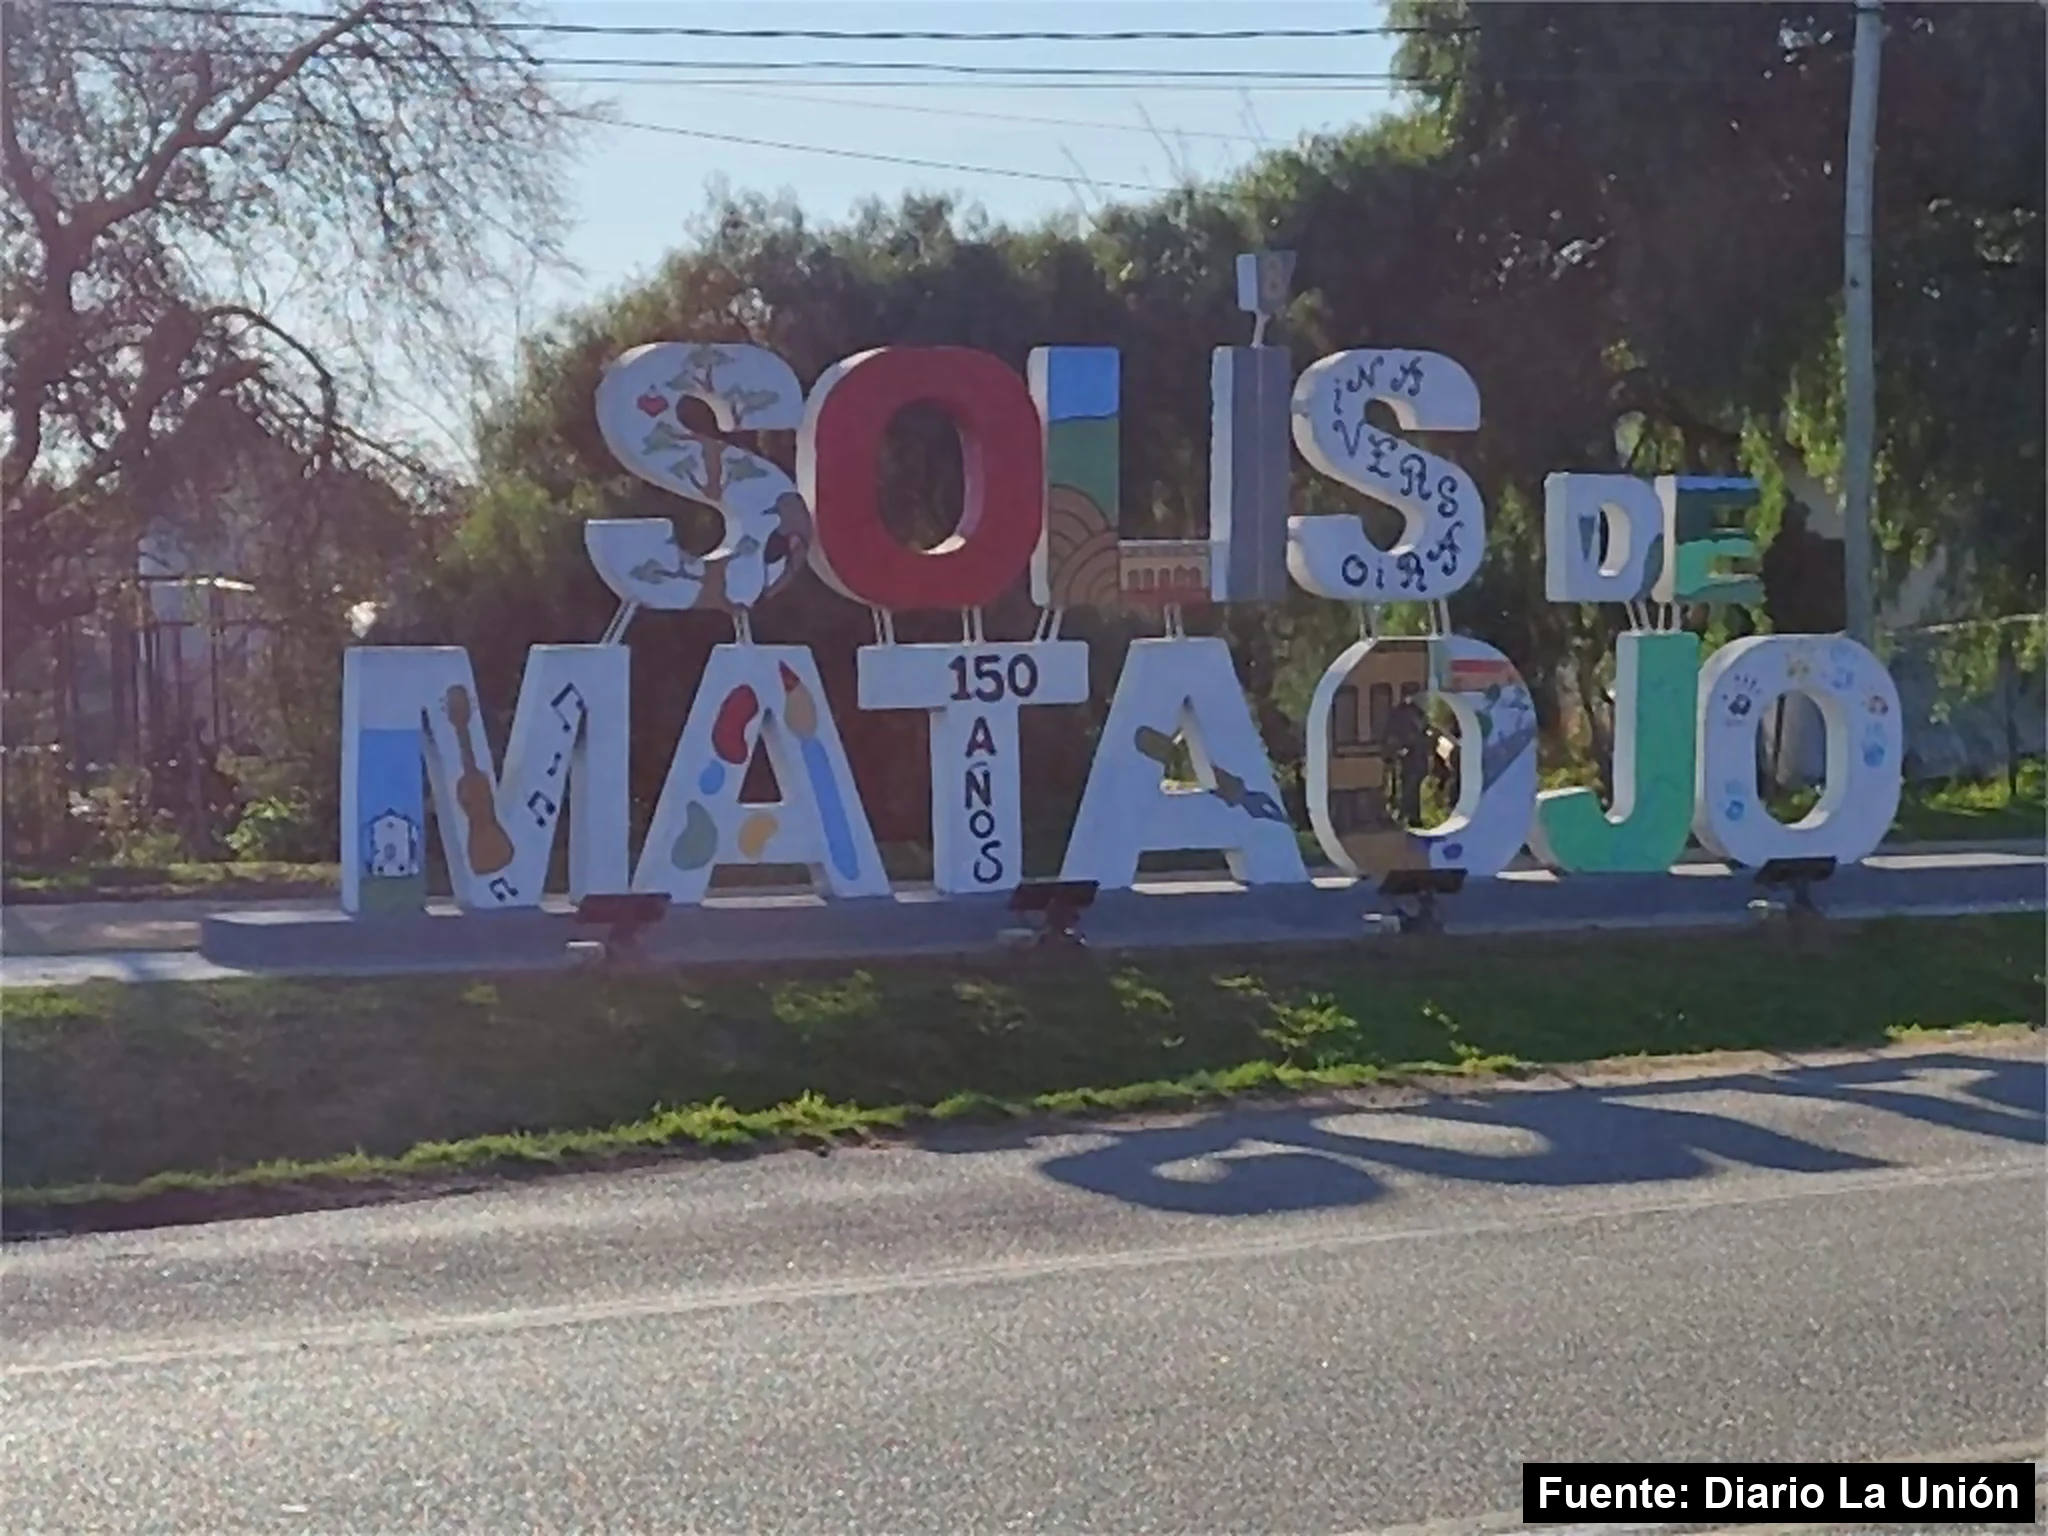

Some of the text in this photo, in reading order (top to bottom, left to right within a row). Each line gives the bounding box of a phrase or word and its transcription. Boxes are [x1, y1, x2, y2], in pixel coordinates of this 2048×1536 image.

[1544, 472, 1767, 602] DE
[948, 653, 1038, 703] 150
[341, 631, 1902, 915] MATAOJO
[964, 716, 1004, 884] AÑOS
